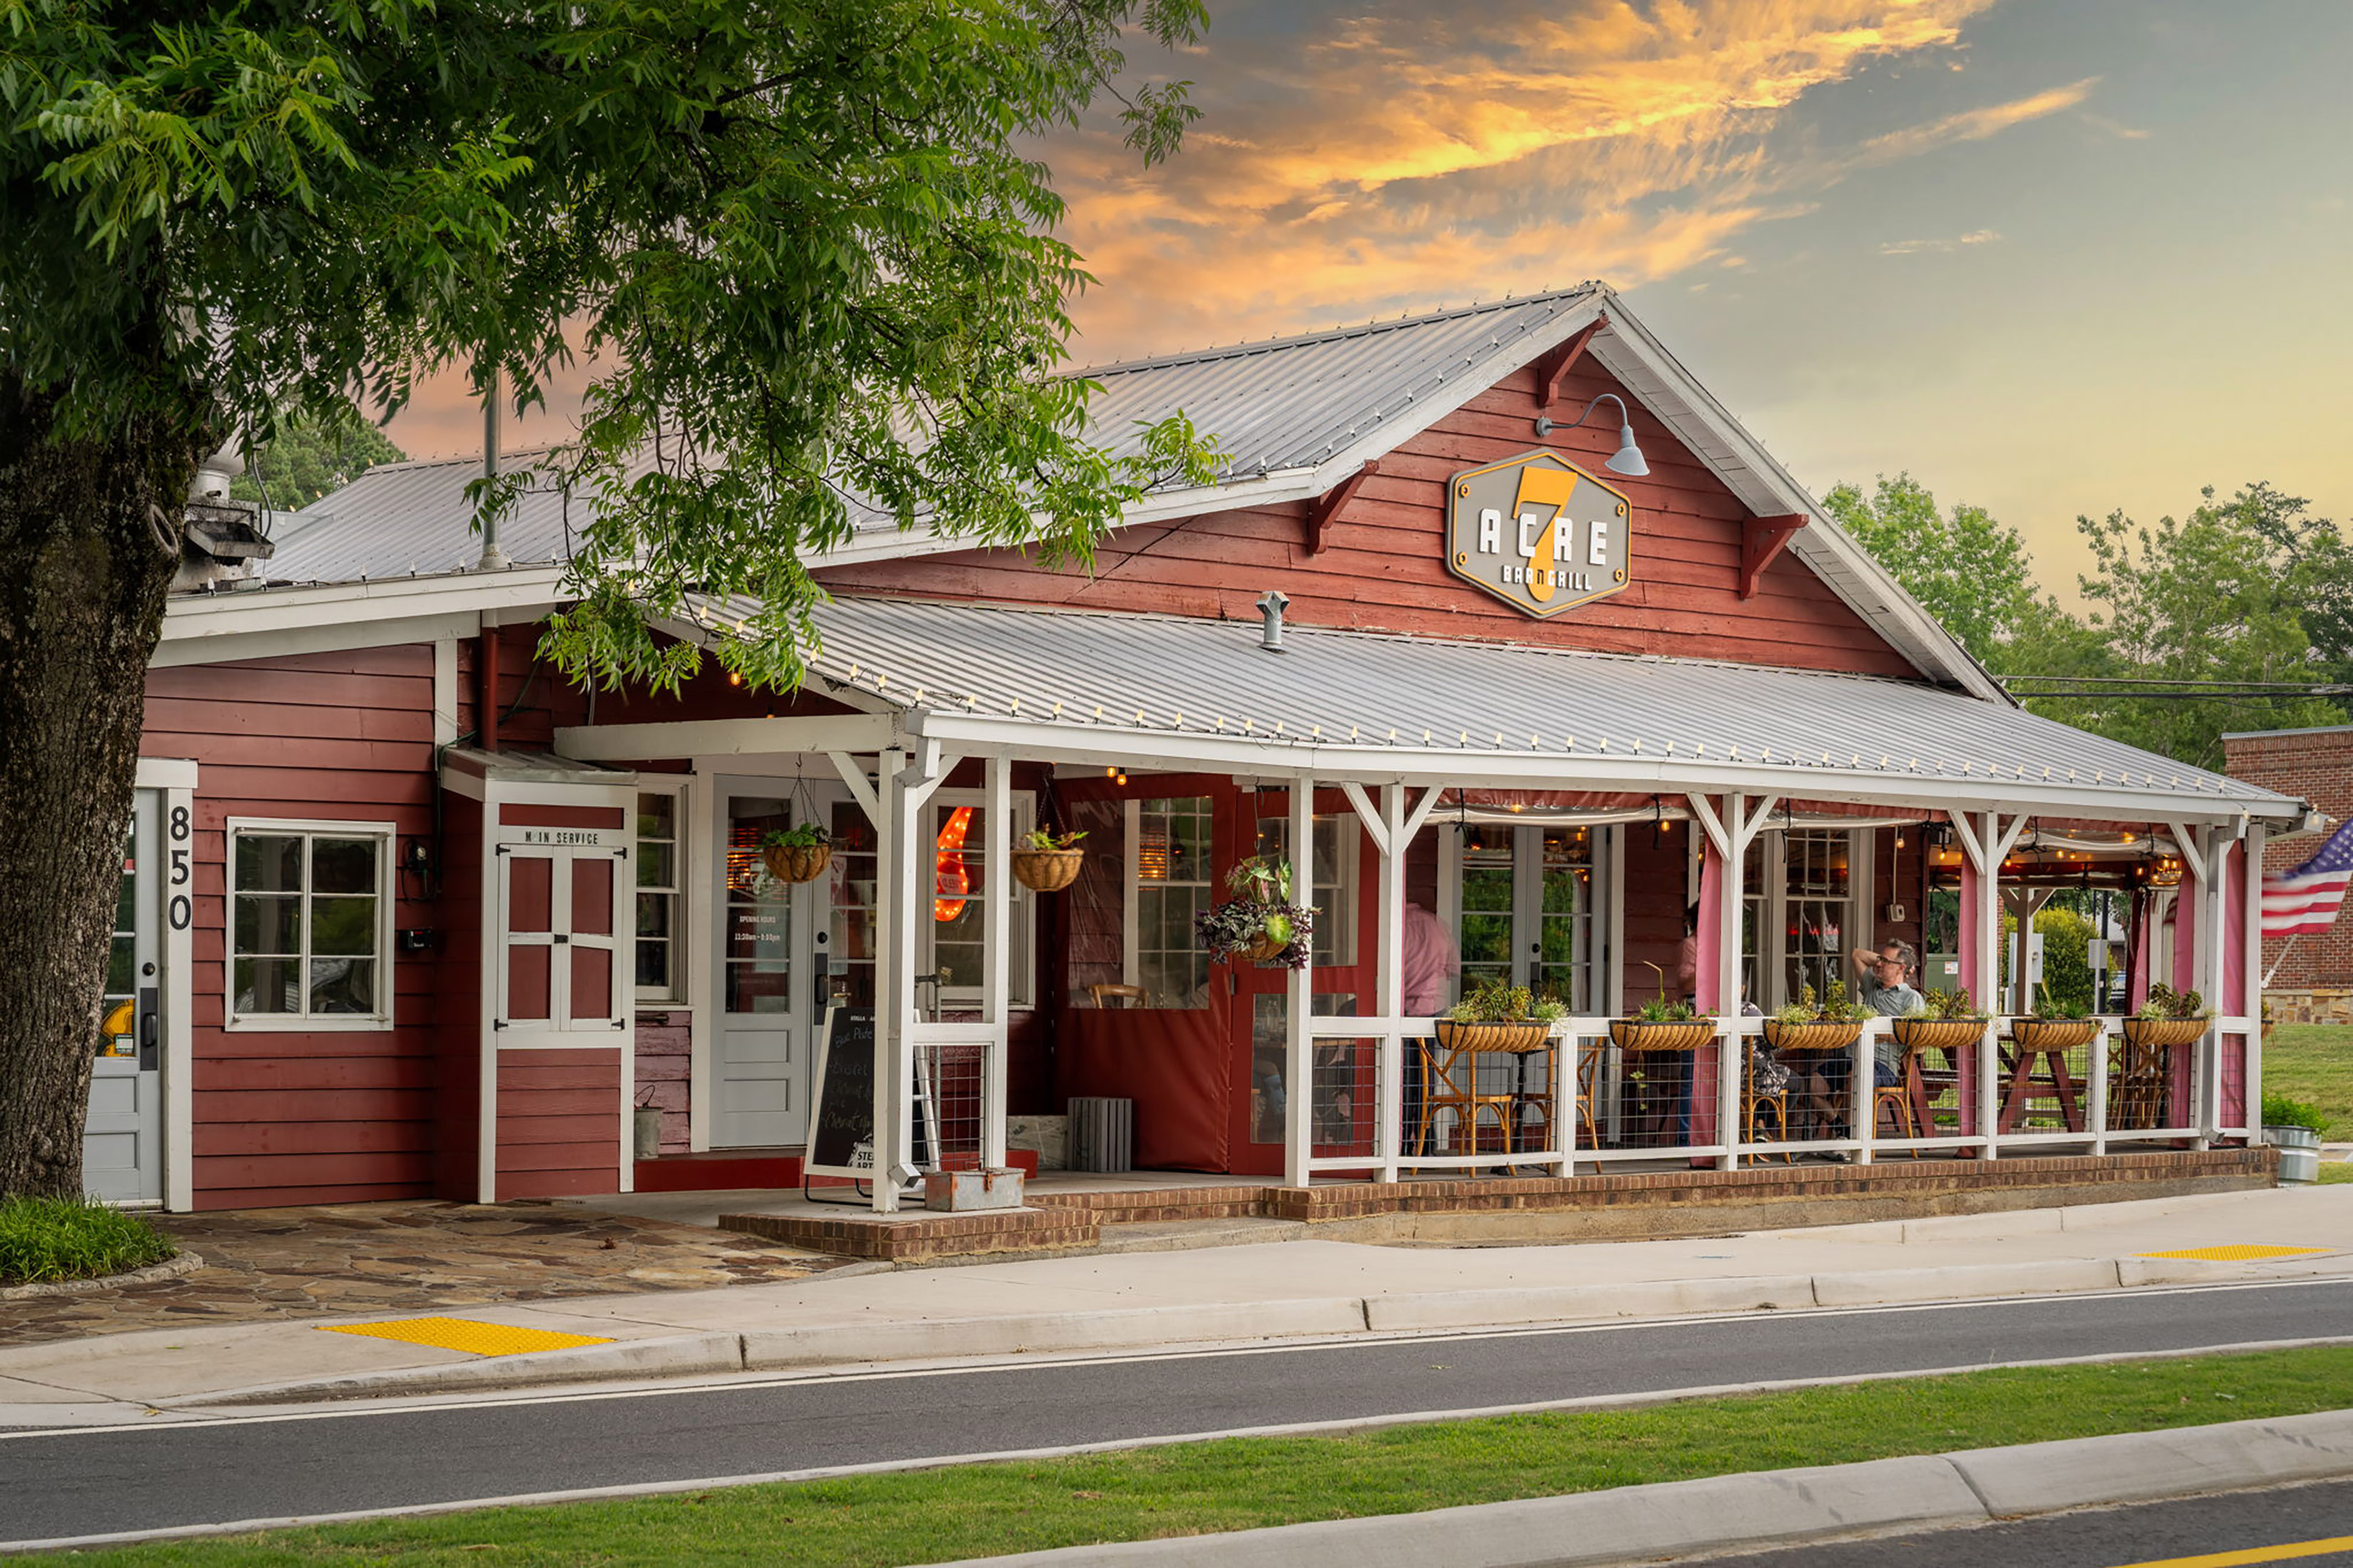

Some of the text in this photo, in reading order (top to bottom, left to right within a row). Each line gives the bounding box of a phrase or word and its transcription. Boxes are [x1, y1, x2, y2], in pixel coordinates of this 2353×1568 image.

[1479, 508, 1608, 566] ACRE
[1512, 465, 1578, 602] 7
[1502, 564, 1534, 584] BAR
[1547, 569, 1592, 591] GRILL
[556, 832, 598, 845] SERVICE
[169, 805, 191, 931] 850
